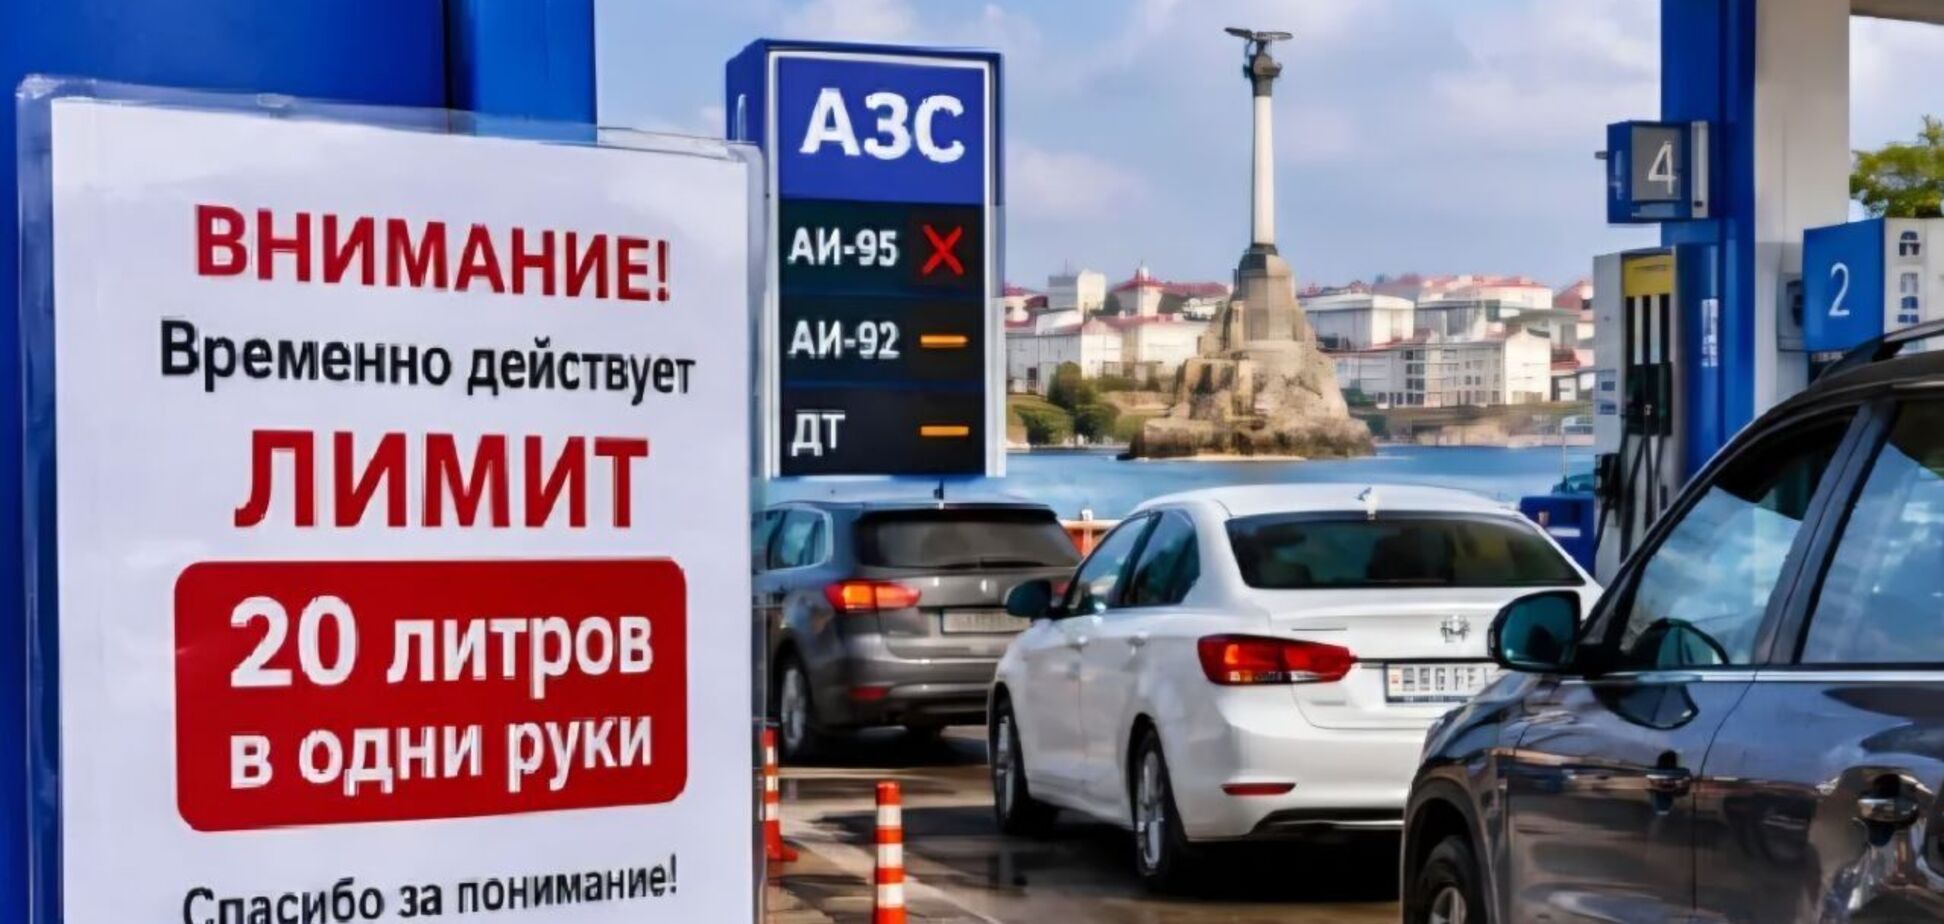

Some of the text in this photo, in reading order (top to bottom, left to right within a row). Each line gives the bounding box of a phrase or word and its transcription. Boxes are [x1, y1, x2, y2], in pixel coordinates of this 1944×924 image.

[799, 87, 965, 163] АЗС
[1648, 140, 1677, 194] 4
[195, 204, 671, 302] ВНИМАНИЕ!
[788, 227, 899, 268] АИ-95
[1828, 263, 1850, 316] 2
[160, 318, 695, 405] Временно действует
[788, 320, 900, 360] АИ-92
[791, 409, 845, 457] ДТ
[234, 429, 649, 529] ЛИМИТ
[230, 595, 653, 698] 20 литров
[230, 715, 652, 795] в одни руки
[183, 855, 678, 924] Спасибо за понимание!
